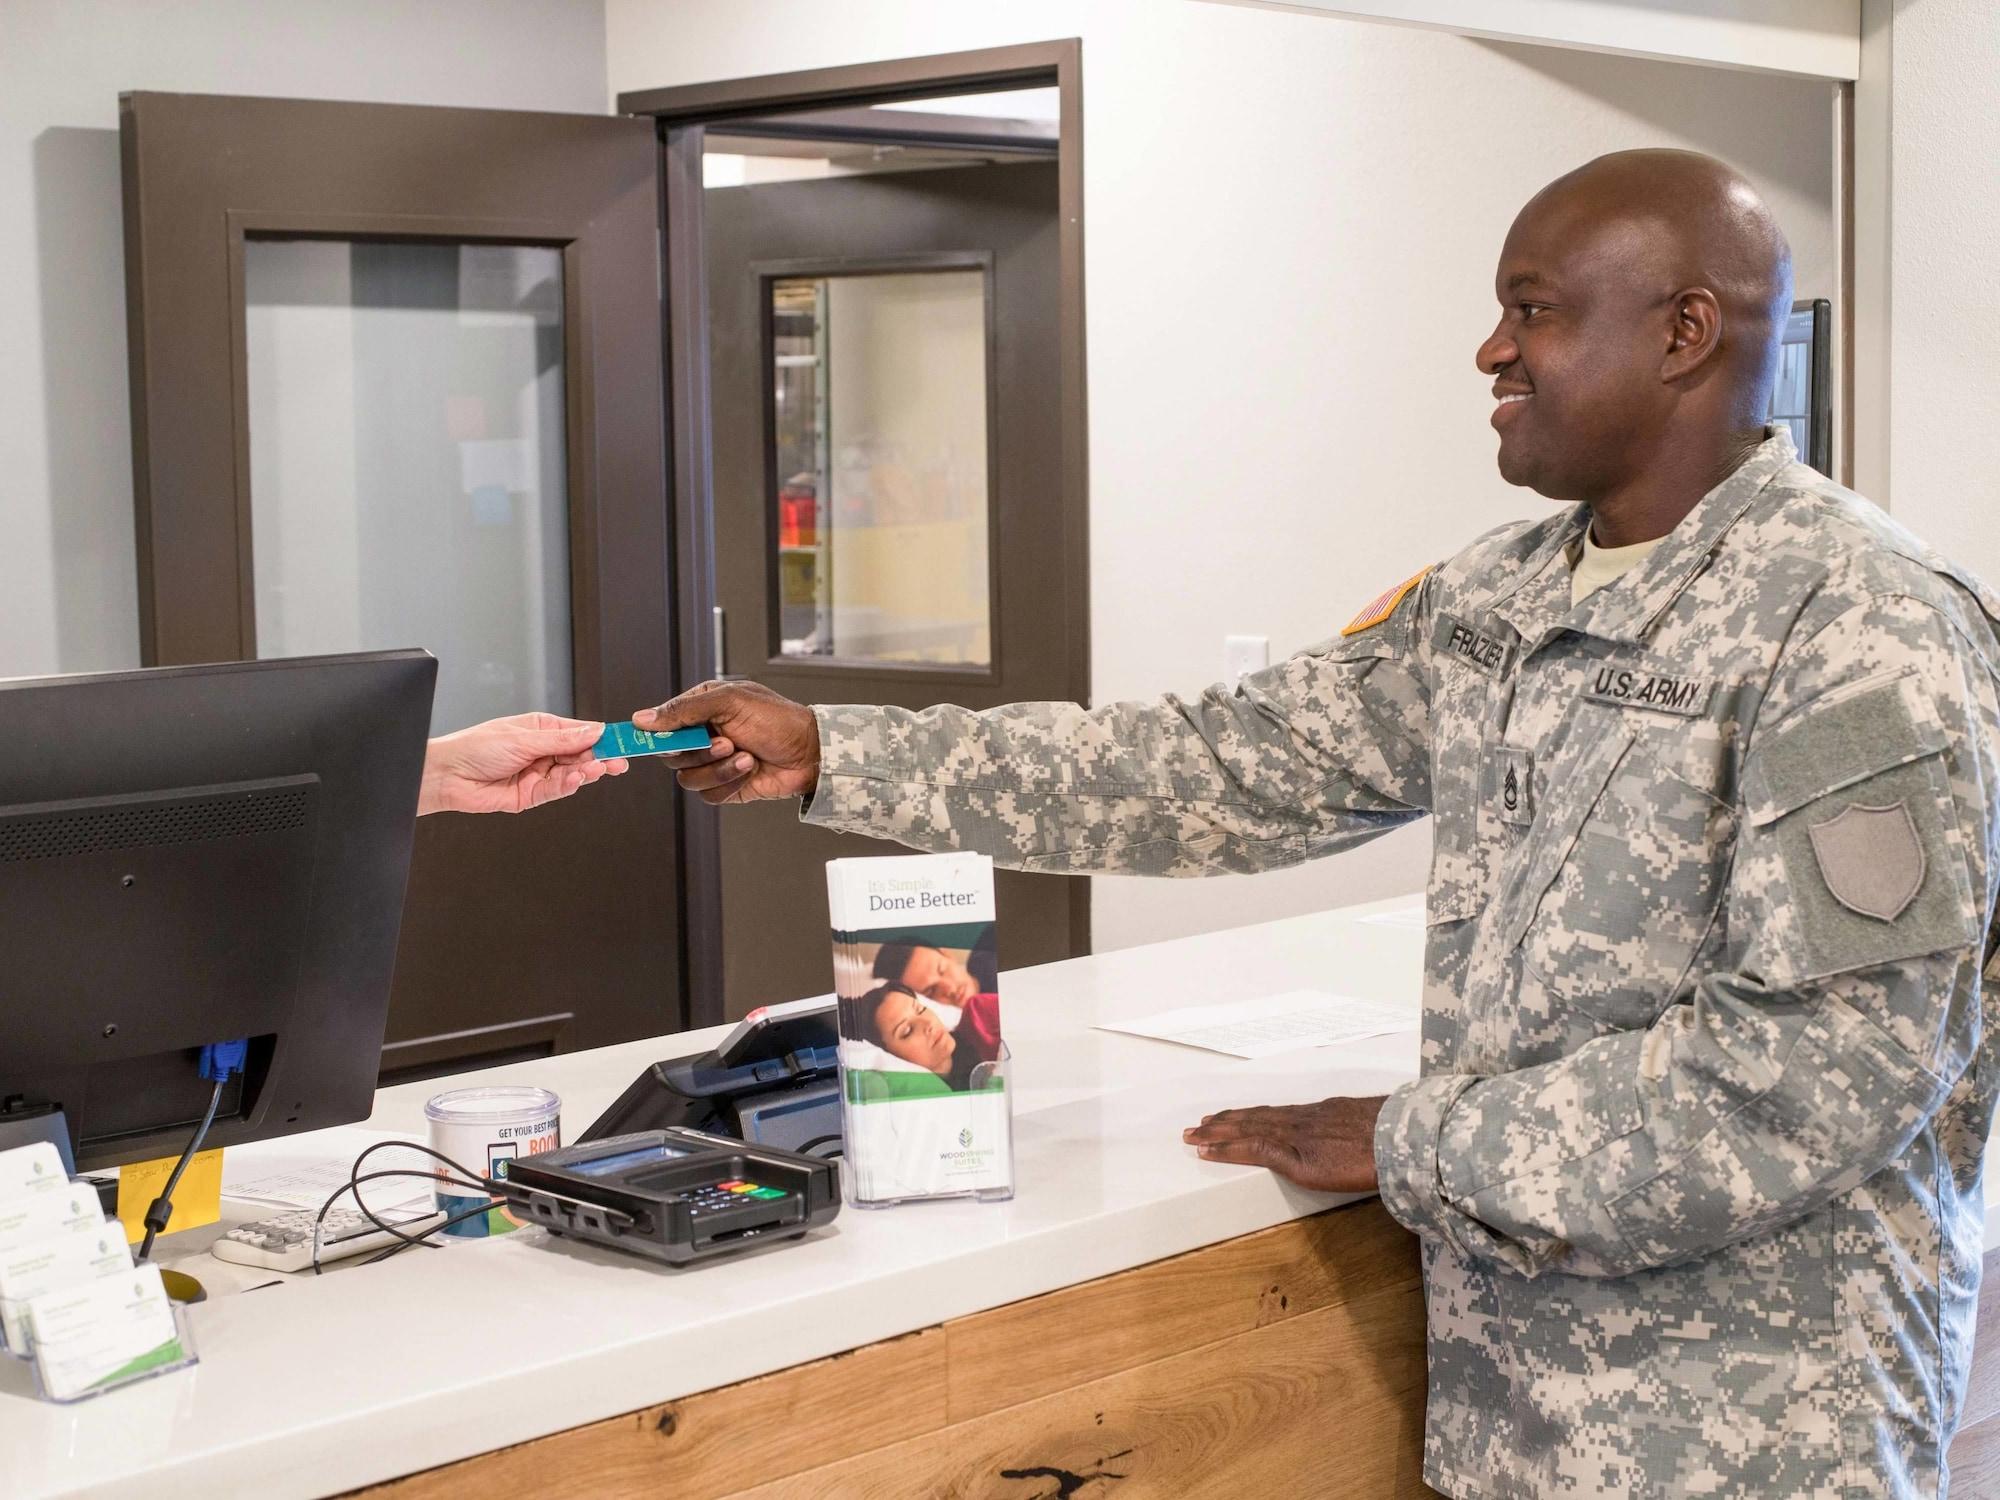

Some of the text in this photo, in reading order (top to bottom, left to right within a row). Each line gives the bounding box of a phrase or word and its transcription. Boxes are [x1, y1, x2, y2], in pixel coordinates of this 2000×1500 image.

[1447, 623, 1504, 671] FRAZIER
[1595, 667, 1701, 708] U.S. ARMY
[869, 891, 976, 911] Done Better.
[498, 1128, 512, 1139] GET
[514, 1125, 532, 1137] YOUR
[534, 1121, 547, 1134] BEST
